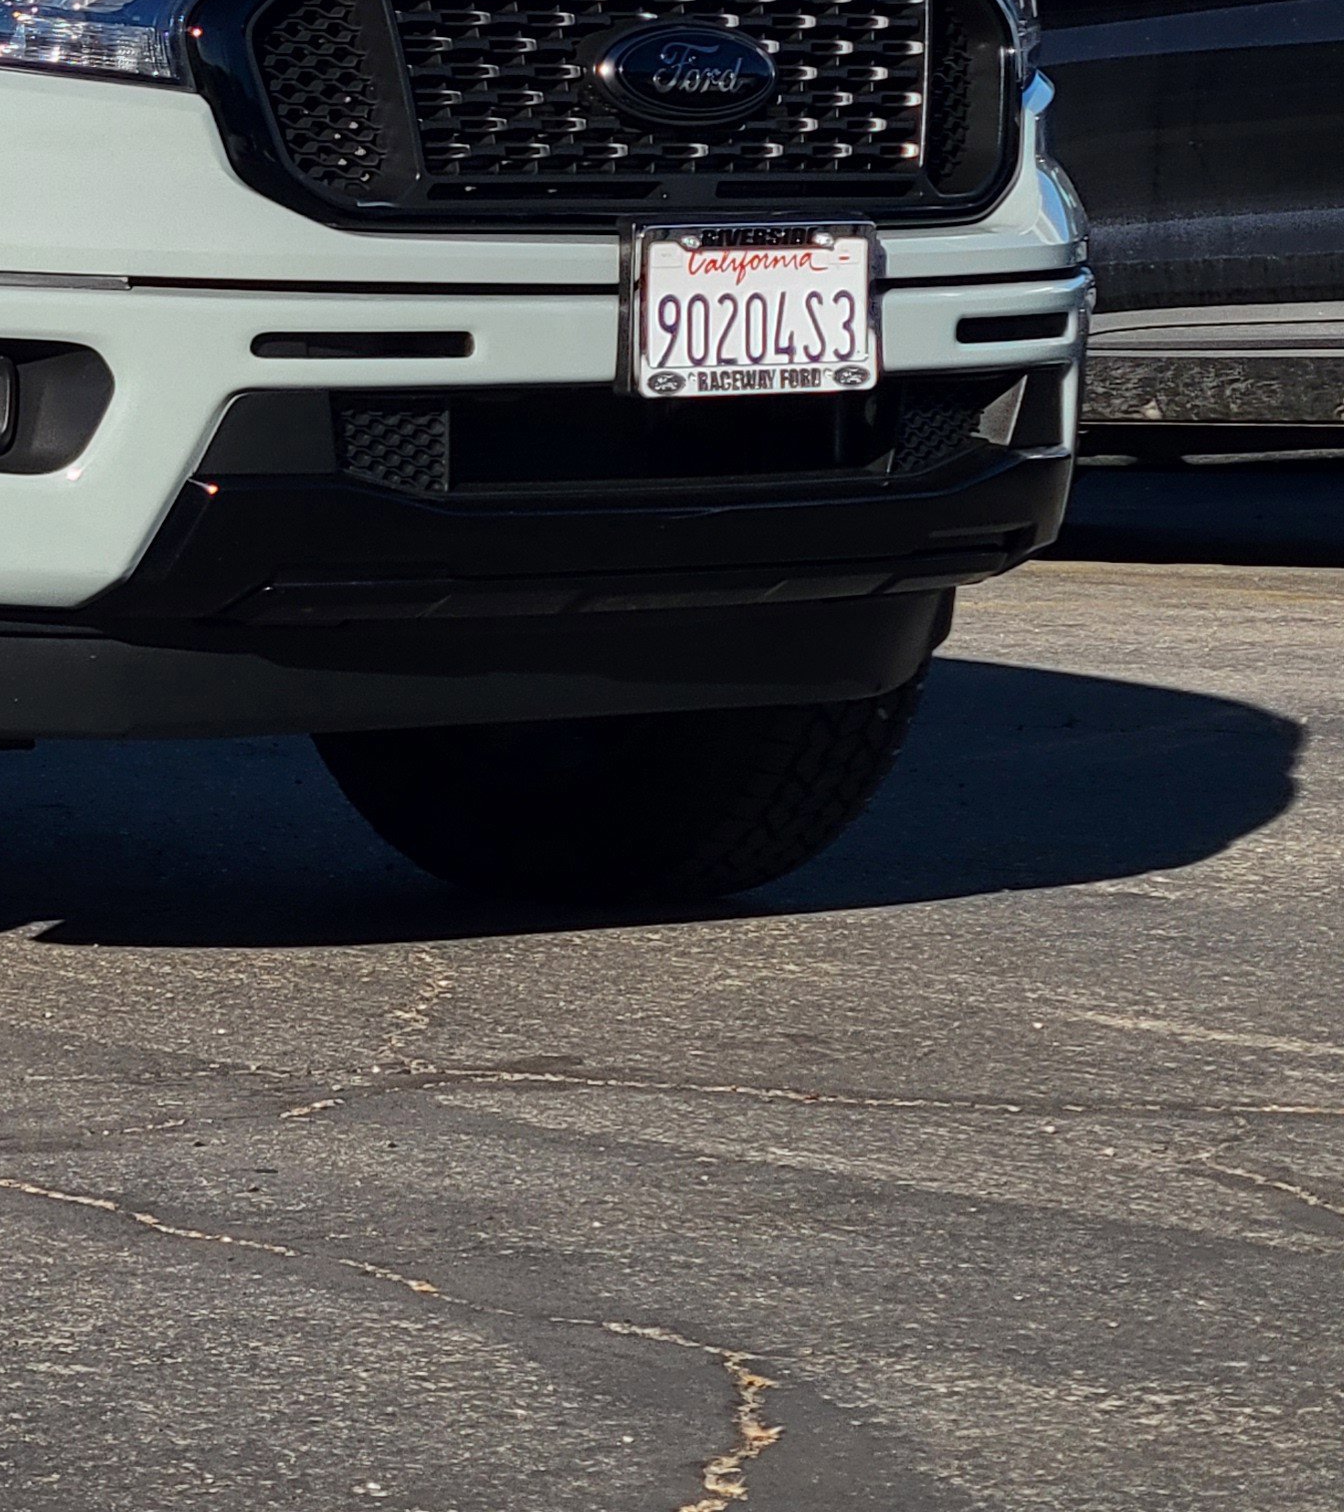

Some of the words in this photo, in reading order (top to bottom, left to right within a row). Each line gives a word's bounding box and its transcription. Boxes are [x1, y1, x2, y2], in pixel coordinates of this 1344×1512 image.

[652, 41, 746, 93] Ford
[689, 250, 828, 285] California
[657, 290, 856, 368] 90204S3
[696, 369, 776, 391] RACEWAY
[780, 368, 821, 389] FORD
